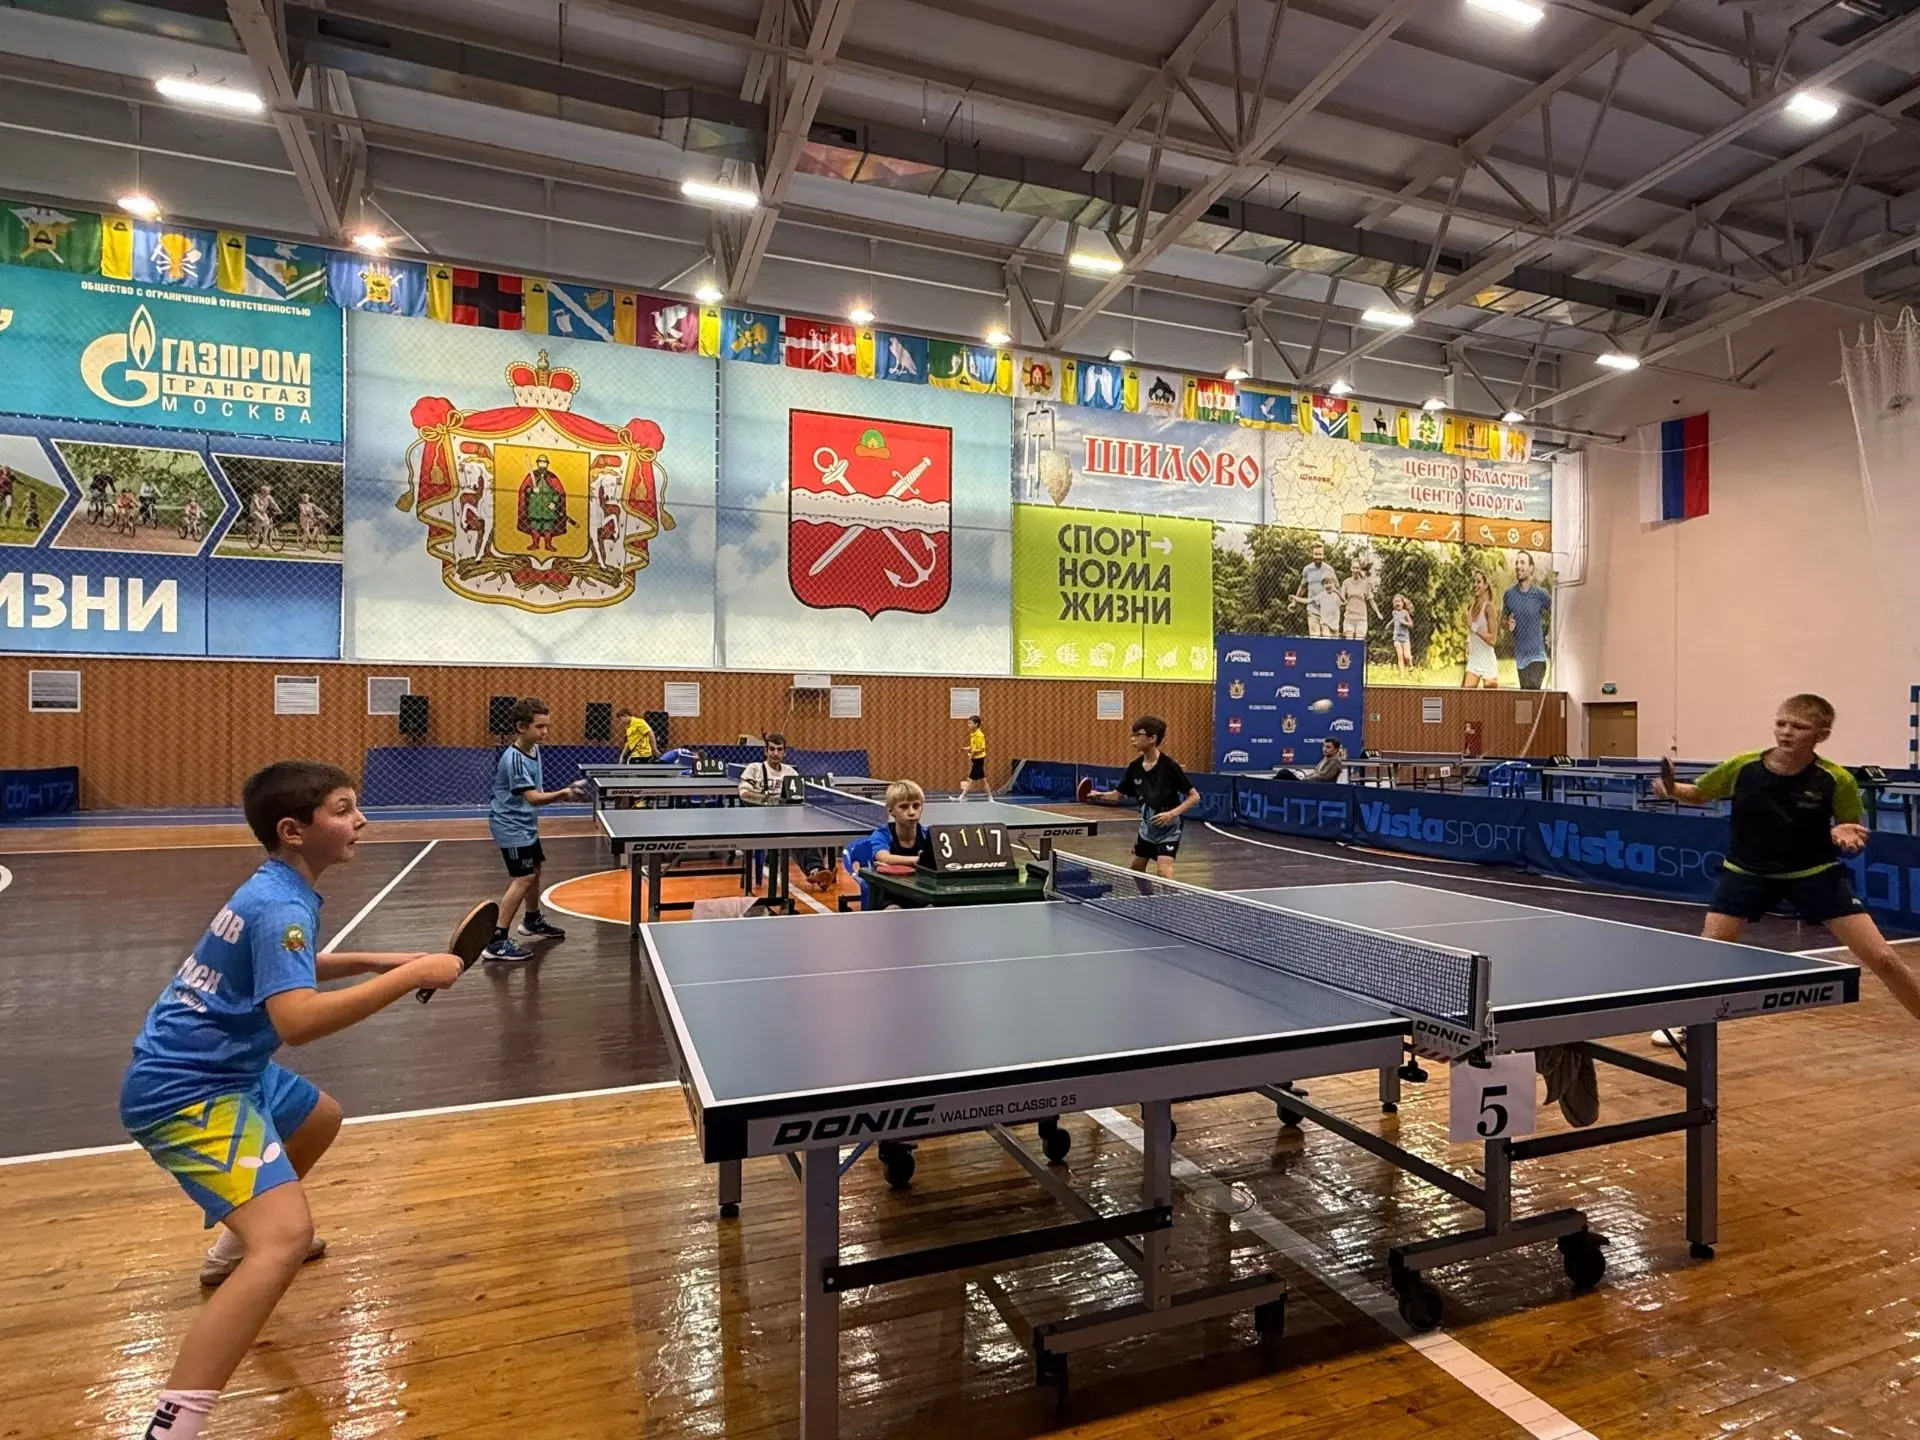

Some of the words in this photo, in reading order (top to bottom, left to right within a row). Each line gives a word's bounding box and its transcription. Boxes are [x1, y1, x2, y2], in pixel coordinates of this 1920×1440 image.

[81, 281, 134, 296] ОБЩЕСТВО
[136, 288, 144, 296] С
[145, 290, 218, 306] ОГРАНИЧЕННОЙ
[219, 298, 311, 316] ОТВЕТСТВЕННОСТЬЮ
[162, 337, 310, 385] ГАЗПРОМ
[166, 377, 307, 404] ТРАНСГАЗ
[162, 396, 311, 424] МОСКВА
[1083, 437, 1260, 490] ШИЛОВО
[1057, 524, 1151, 558] СПОРТ
[1059, 557, 1171, 592] НОРМА
[1058, 591, 1171, 625] ЖИЗНИ
[789, 779, 796, 793] 4
[940, 832, 953, 858] 3
[960, 828, 968, 846] 1
[976, 828, 984, 846] 1
[990, 830, 1001, 855] 7
[1043, 828, 1083, 837] DONIC
[1360, 801, 1526, 852] VistaSPORT
[632, 842, 687, 851] DONIC
[1539, 819, 1727, 886] VistaSPO
[963, 861, 1007, 869] DONIC
[1761, 985, 1834, 1010] DONIC
[1415, 1020, 1472, 1047] DONIC
[773, 1104, 935, 1146] DONIC
[940, 1105, 1004, 1124] WALDNER
[1007, 1097, 1058, 1114] CLASSIC
[1061, 1094, 1077, 1106] 25
[1476, 1085, 1508, 1137] 5
